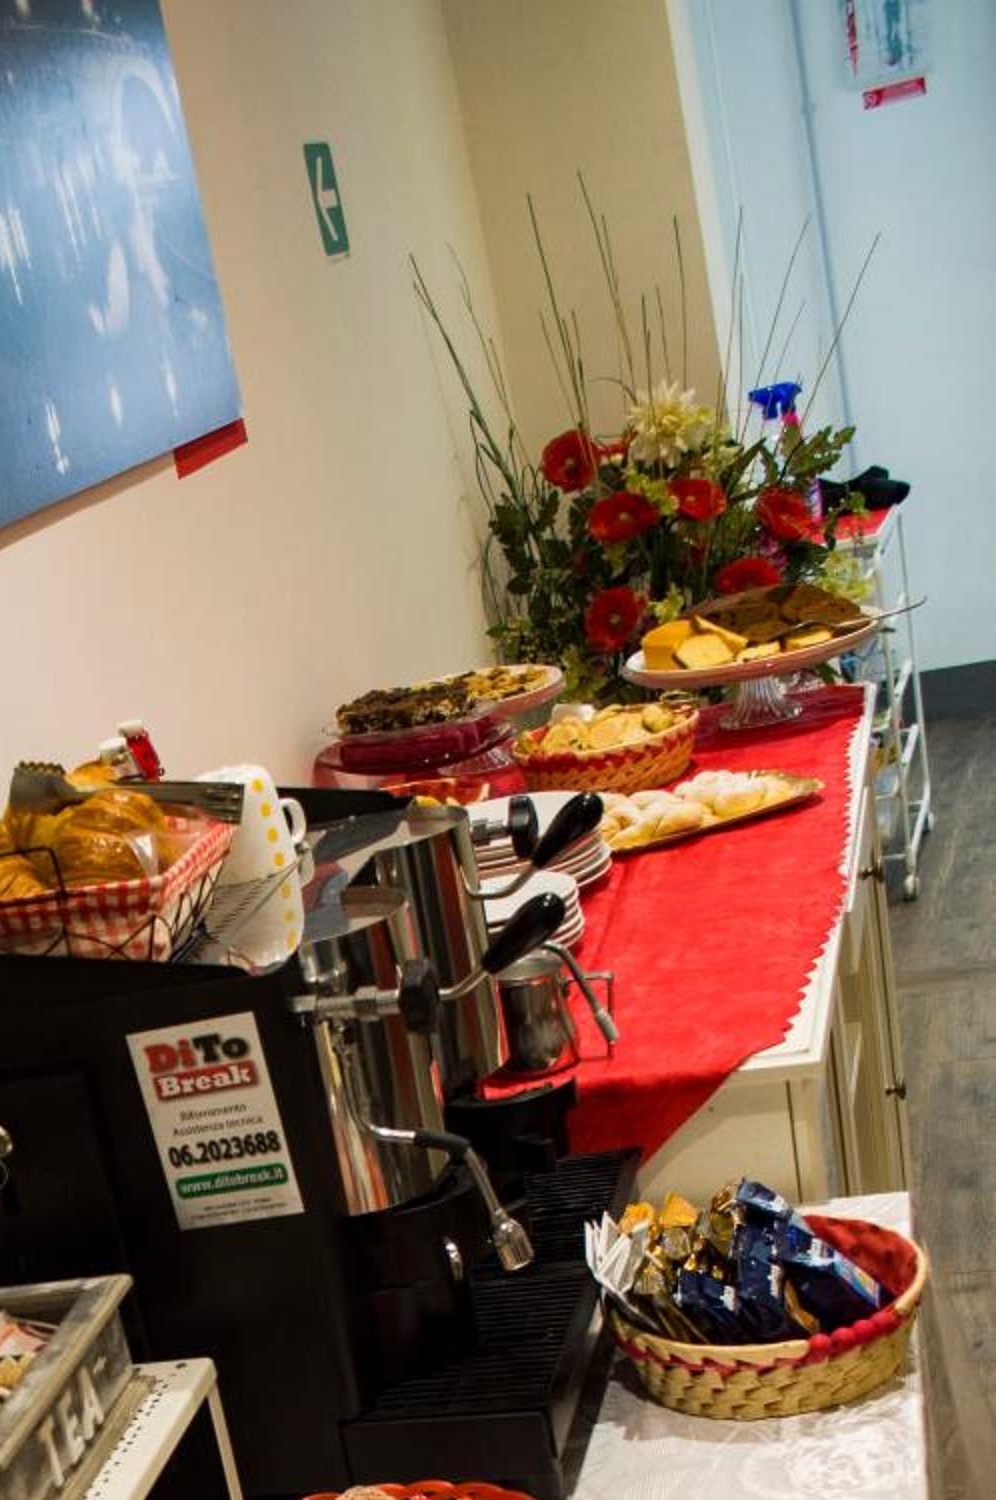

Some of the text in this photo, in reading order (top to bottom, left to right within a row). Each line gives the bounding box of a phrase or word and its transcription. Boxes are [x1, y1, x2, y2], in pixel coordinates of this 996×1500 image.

[144, 1033, 250, 1073] DiTo
[156, 1065, 252, 1097] Break
[168, 1129, 281, 1168] 06.2023688
